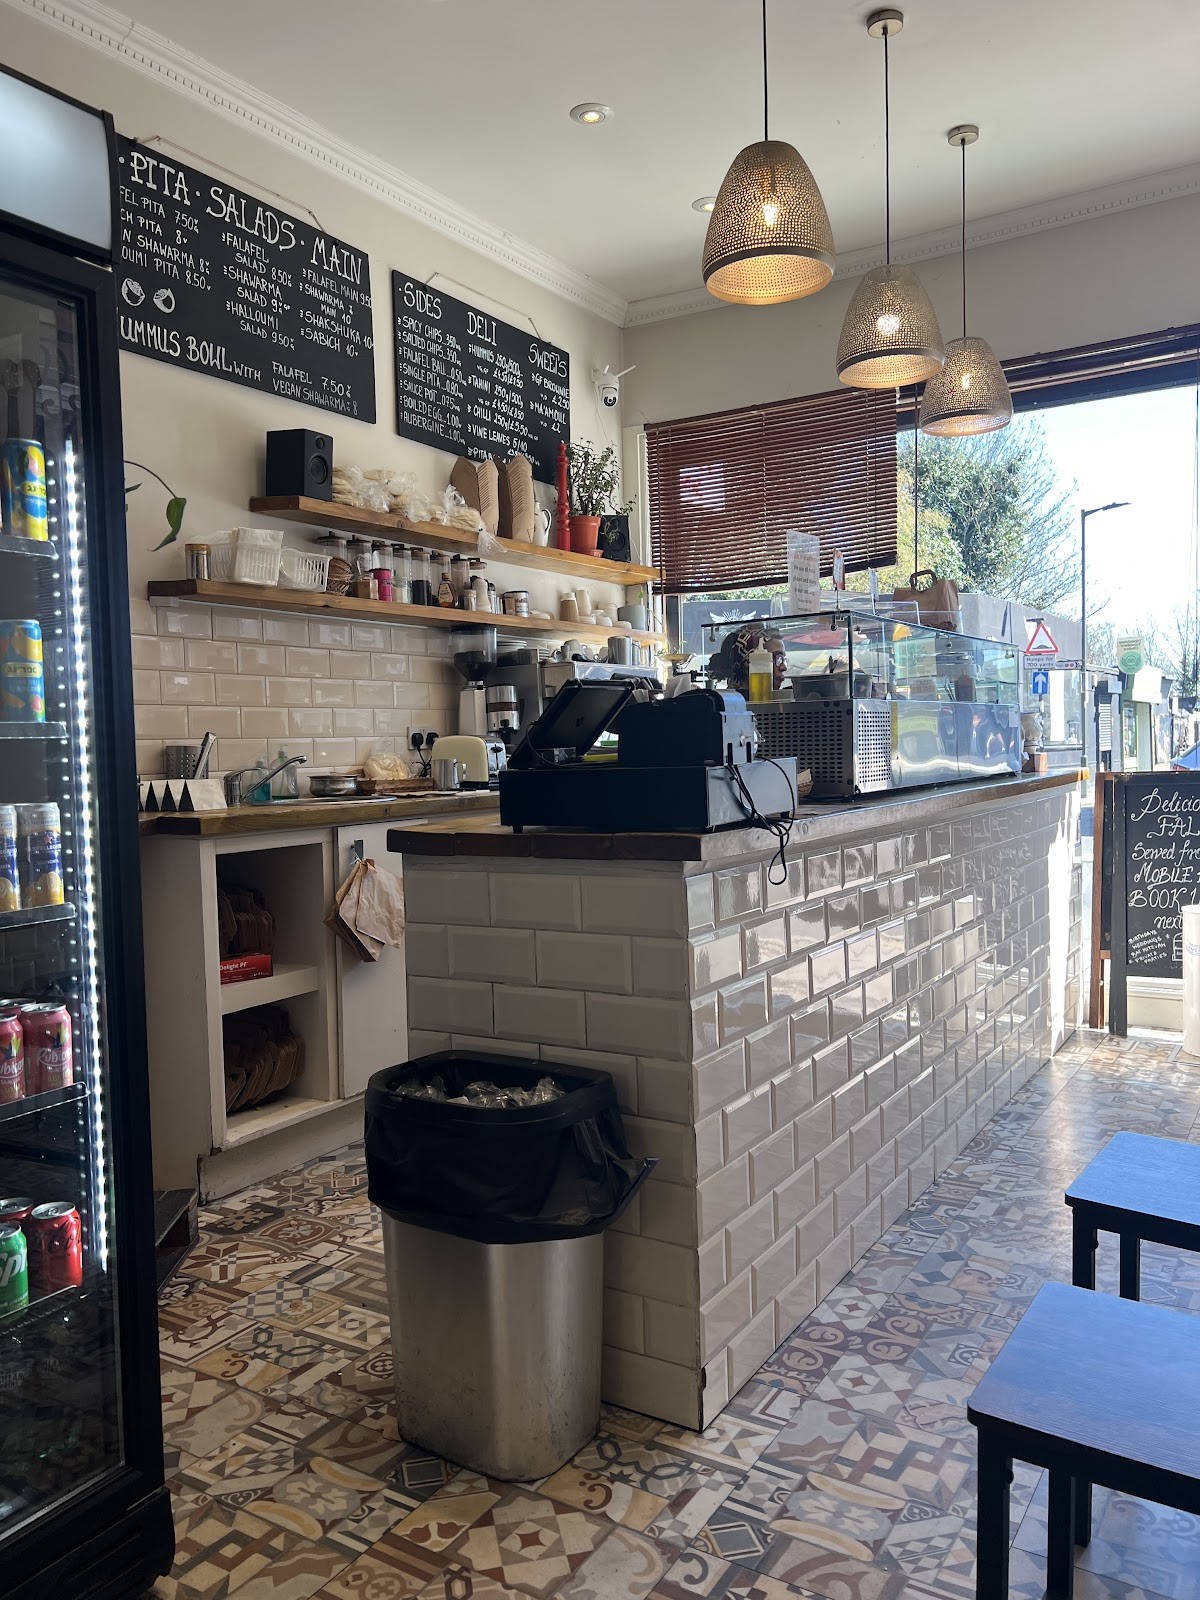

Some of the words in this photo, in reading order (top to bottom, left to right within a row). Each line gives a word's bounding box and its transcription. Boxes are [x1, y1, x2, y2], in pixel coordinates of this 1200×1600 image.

[130, 151, 191, 206] PITA
[206, 186, 296, 251] SALADS
[310, 236, 362, 284] MAIN
[137, 216, 162, 236] PITA
[140, 197, 166, 218] PITA
[174, 210, 194, 230] 7.50
[137, 234, 195, 269] SHAWARMA
[226, 232, 269, 263] FALAFEL
[121, 245, 147, 268] OUMI
[154, 258, 179, 279] PITA
[185, 270, 206, 289] 8.50
[235, 252, 266, 274] SALAD
[228, 265, 282, 301] SHAWARMA
[307, 269, 340, 294] FALAFEL
[340, 284, 359, 303] MAIN
[237, 286, 267, 307] SALAD
[304, 283, 345, 310] SHAWARMA
[403, 282, 442, 320] SIDES
[231, 301, 279, 330] HALLOUMI
[321, 303, 337, 318] MAIN
[341, 313, 352, 325] 10
[240, 320, 268, 339] SALAD
[304, 310, 361, 345] SHAKSHUKA
[402, 316, 422, 334] SPICY
[424, 324, 443, 343] CHIPS
[466, 311, 497, 346] DELI
[120, 315, 181, 357] UMMUS
[185, 335, 232, 372] BOWL
[233, 360, 261, 382] WITH
[304, 327, 341, 352] SABICH
[346, 343, 355, 357] 10
[402, 331, 426, 350] SALTED
[426, 340, 443, 357] CHIPS
[471, 343, 494, 363] HUMMUS
[402, 346, 431, 369] FALAFEL
[431, 357, 447, 376] BALL
[528, 343, 567, 377] SWEETS
[271, 360, 312, 385] FALAFEL
[321, 376, 344, 396] 7.50
[402, 363, 426, 382] SINGLE
[426, 371, 441, 389] PITA
[470, 374, 491, 394] TAHINI
[543, 378, 569, 399] BROWNIE
[272, 378, 301, 398] VEGAN
[302, 387, 346, 411] SHAWARMA
[403, 379, 423, 397] SAUCE
[424, 387, 438, 403] POT
[403, 394, 427, 414] BOILED
[427, 404, 442, 421] EGG
[473, 404, 491, 422] CHILLI
[403, 411, 444, 437] AUBERGINE
[472, 424, 488, 439] VINE
[488, 429, 510, 446] LEAVES
[473, 447, 488, 461] PITA
[1039, 661, 1054, 669] yards
[1131, 841, 1176, 861] Served
[1133, 861, 1194, 890] MOBILE
[1128, 887, 1187, 913] BOOK
[1153, 914, 1183, 929] next
[1127, 929, 1157, 945] BIRTHDAYS
[1131, 935, 1162, 950] WEDDINGS
[1144, 951, 1168, 964] PARTIES
